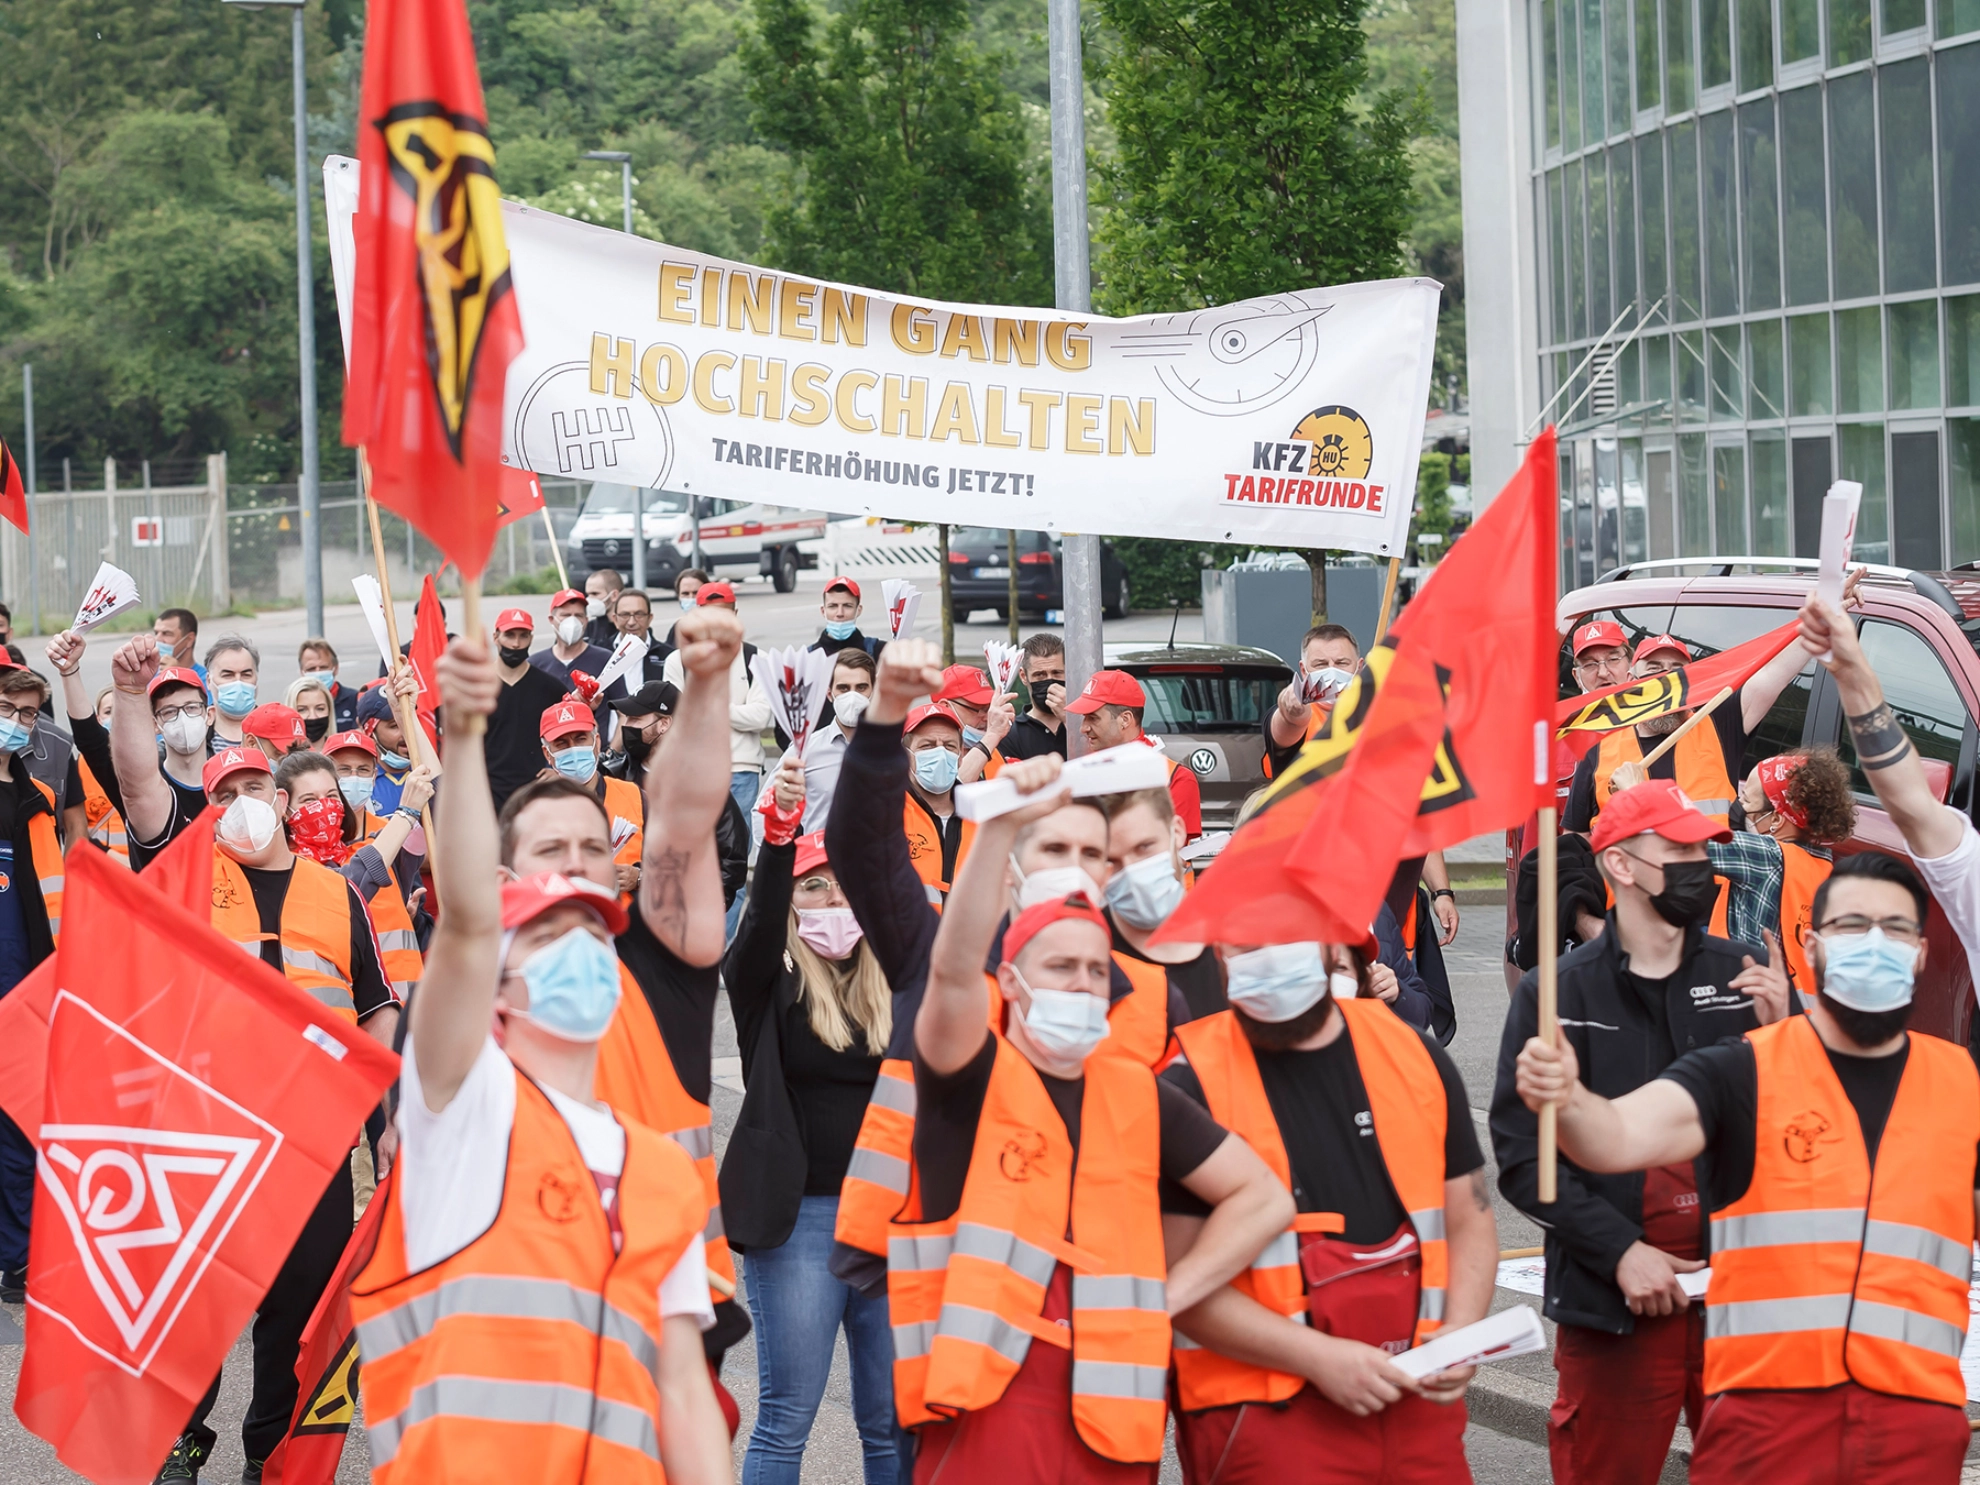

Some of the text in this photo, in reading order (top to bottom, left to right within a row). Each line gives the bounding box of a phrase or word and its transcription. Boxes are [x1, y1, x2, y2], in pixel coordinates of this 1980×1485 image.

[657, 260, 1093, 372] EINEN GANG
[589, 331, 1157, 457] HOCHSCHALTEN
[711, 437, 1036, 497] TARIFERHÖHUNG JETZT!
[1252, 441, 1307, 473] KFZ
[1322, 451, 1338, 464] HU
[1224, 473, 1385, 512] TARIFRUNDE
